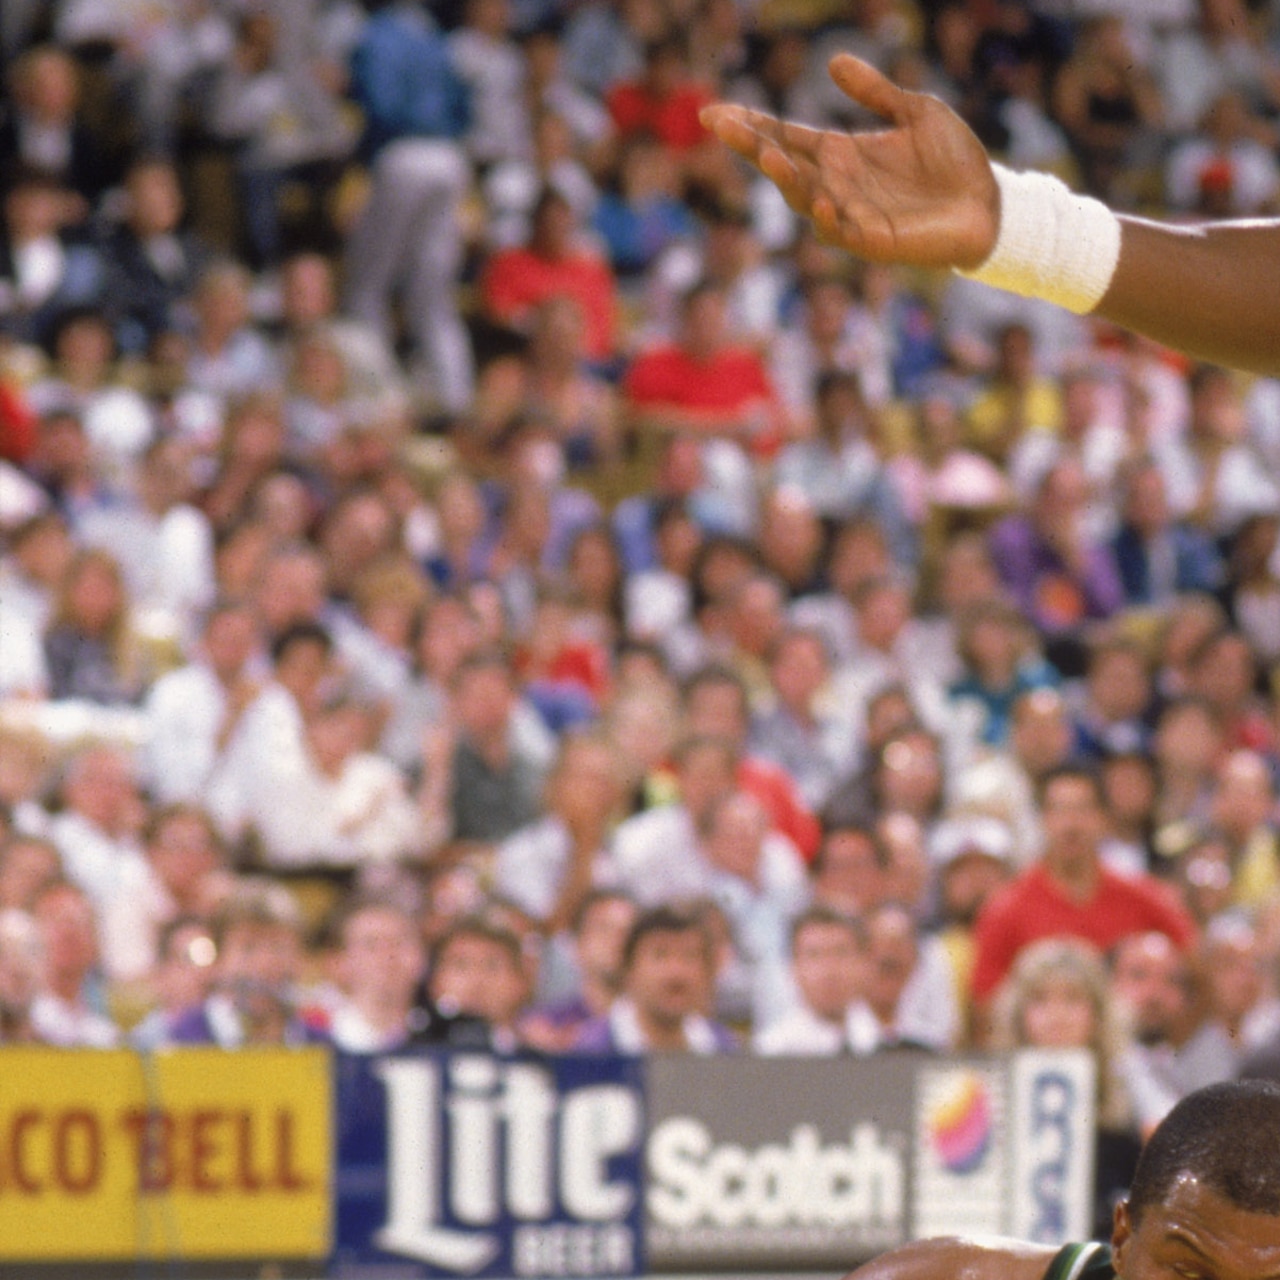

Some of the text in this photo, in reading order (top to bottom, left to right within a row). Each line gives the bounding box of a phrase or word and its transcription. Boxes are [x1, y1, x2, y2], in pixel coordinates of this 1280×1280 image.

[0, 1102, 314, 1197] CO BELL
[374, 1054, 642, 1276] Lite
[644, 1116, 902, 1230] Scotch
